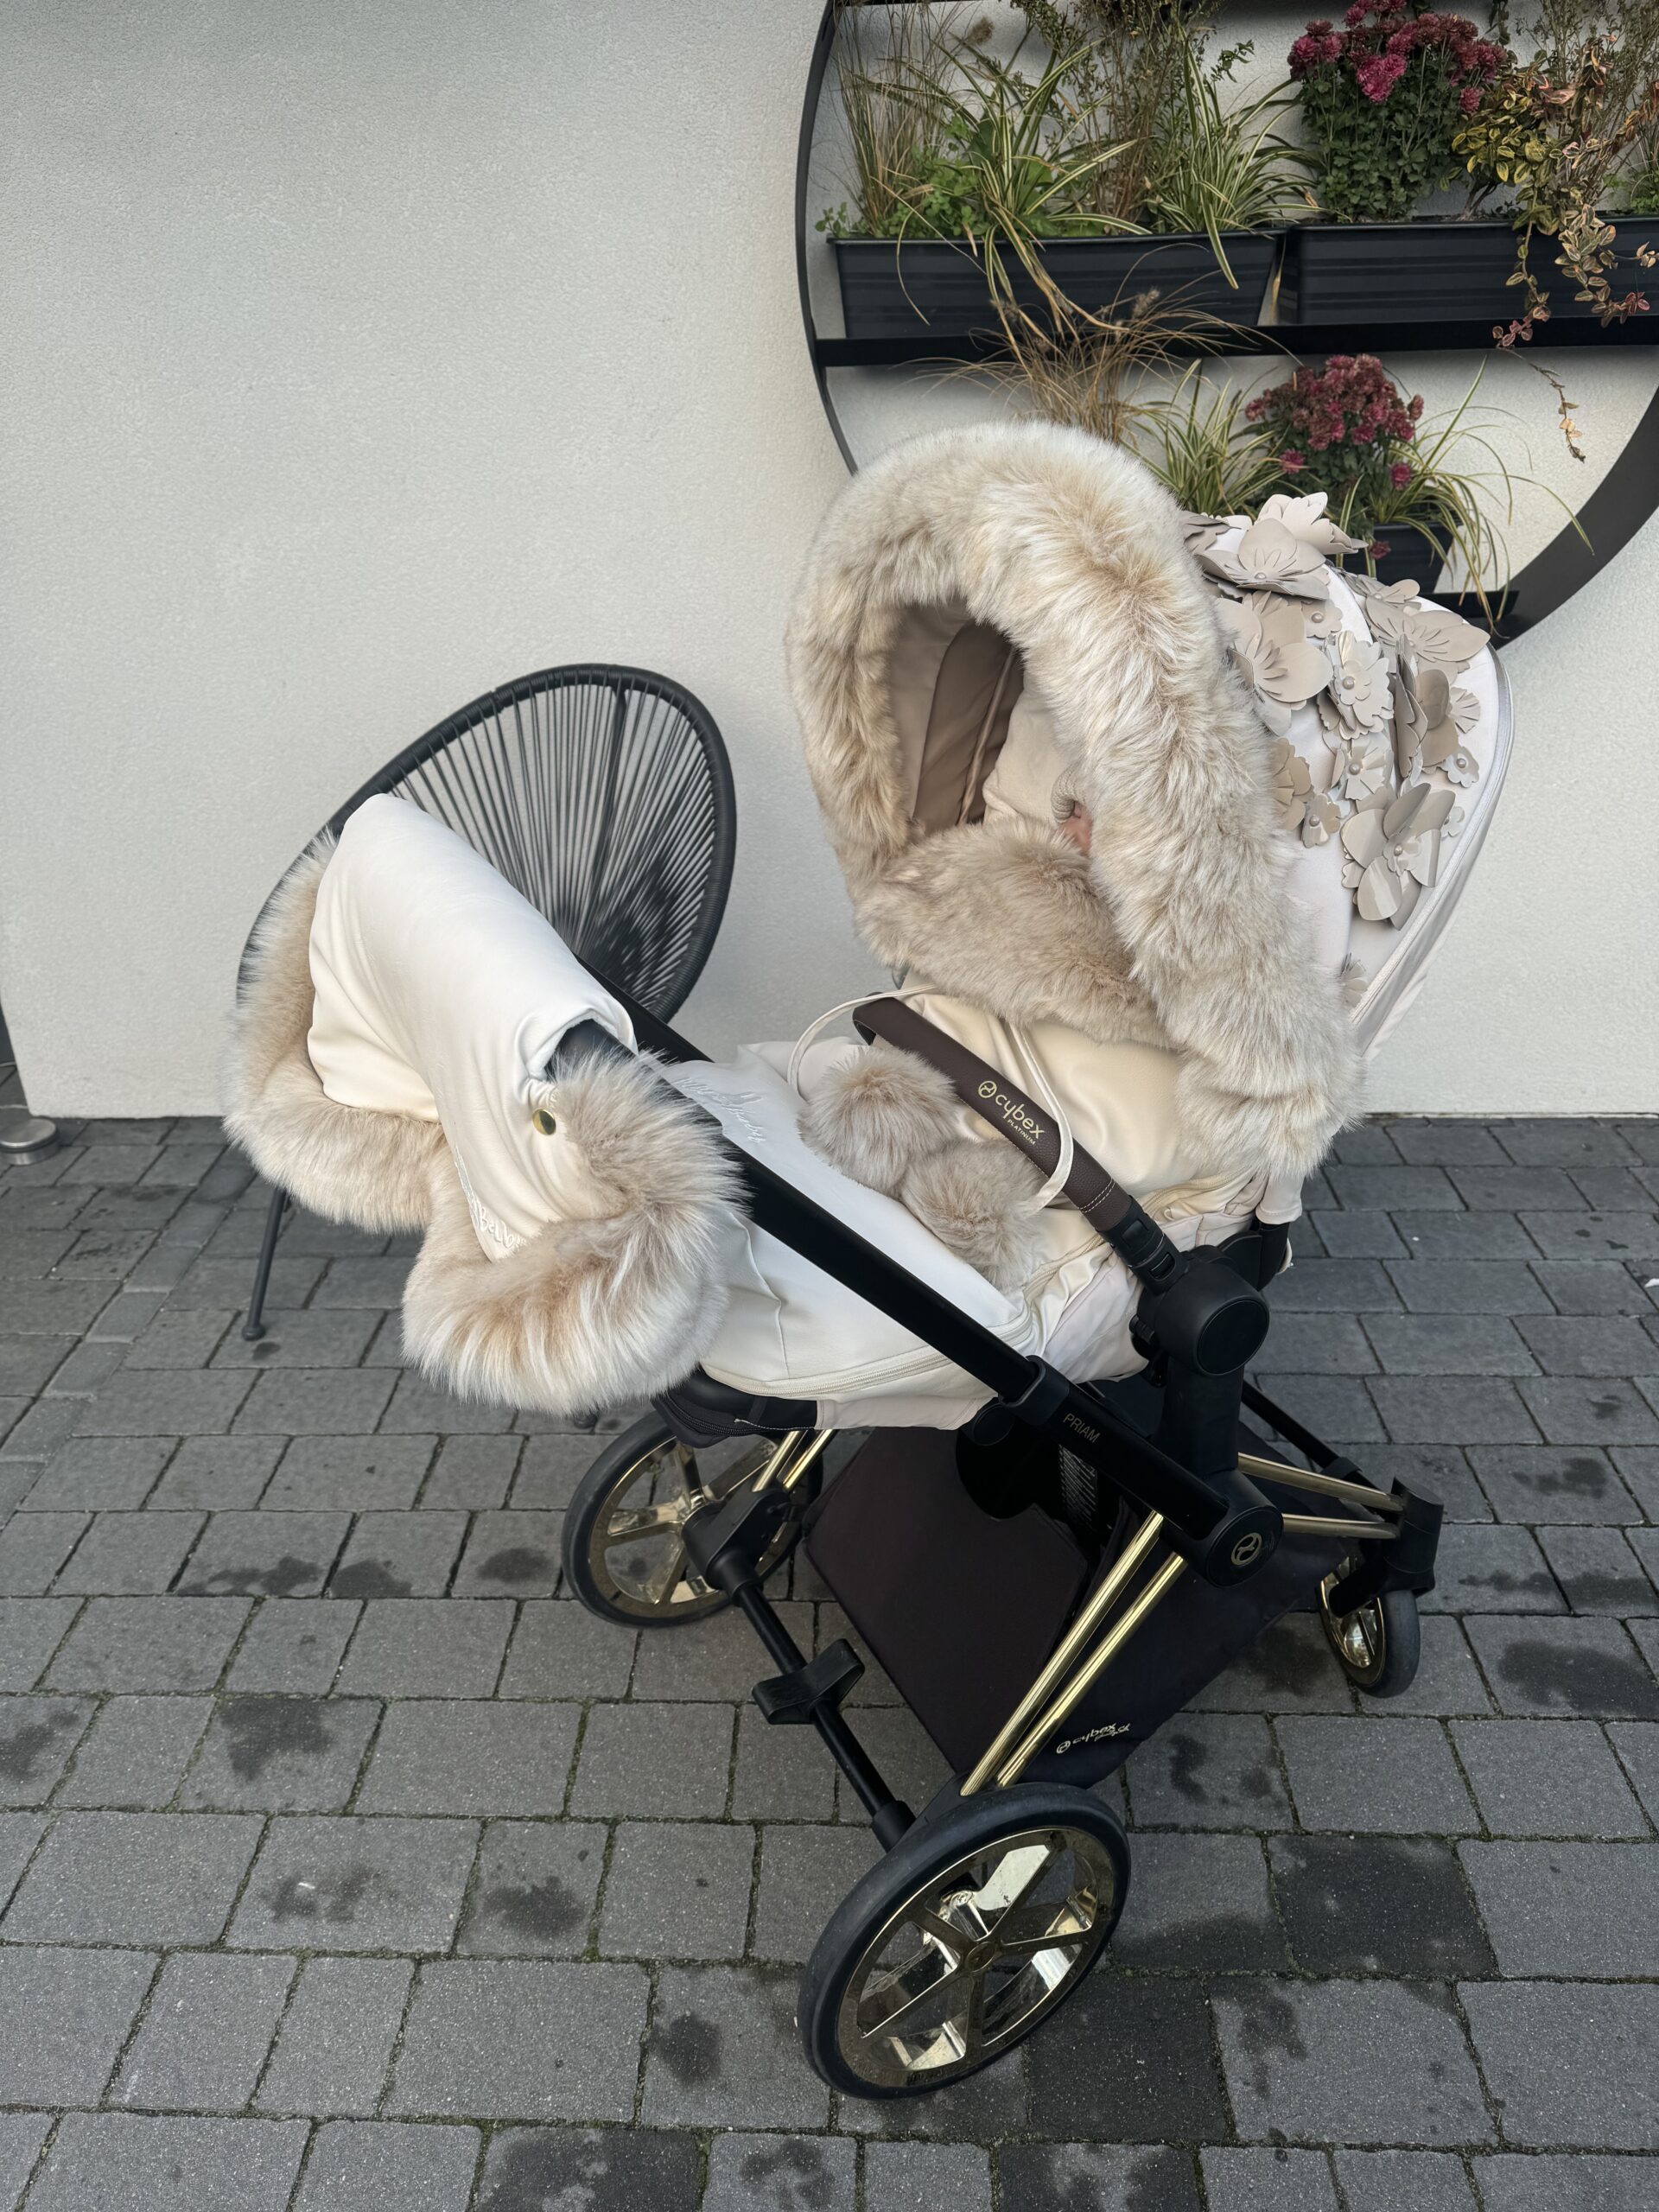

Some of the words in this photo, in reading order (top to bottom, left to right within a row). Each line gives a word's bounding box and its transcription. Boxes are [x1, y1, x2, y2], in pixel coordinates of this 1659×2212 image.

[995, 1094, 1045, 1140] cybex
[1007, 1119, 1036, 1146] PLATINUM
[1063, 1413, 1100, 1443] PRIAM
